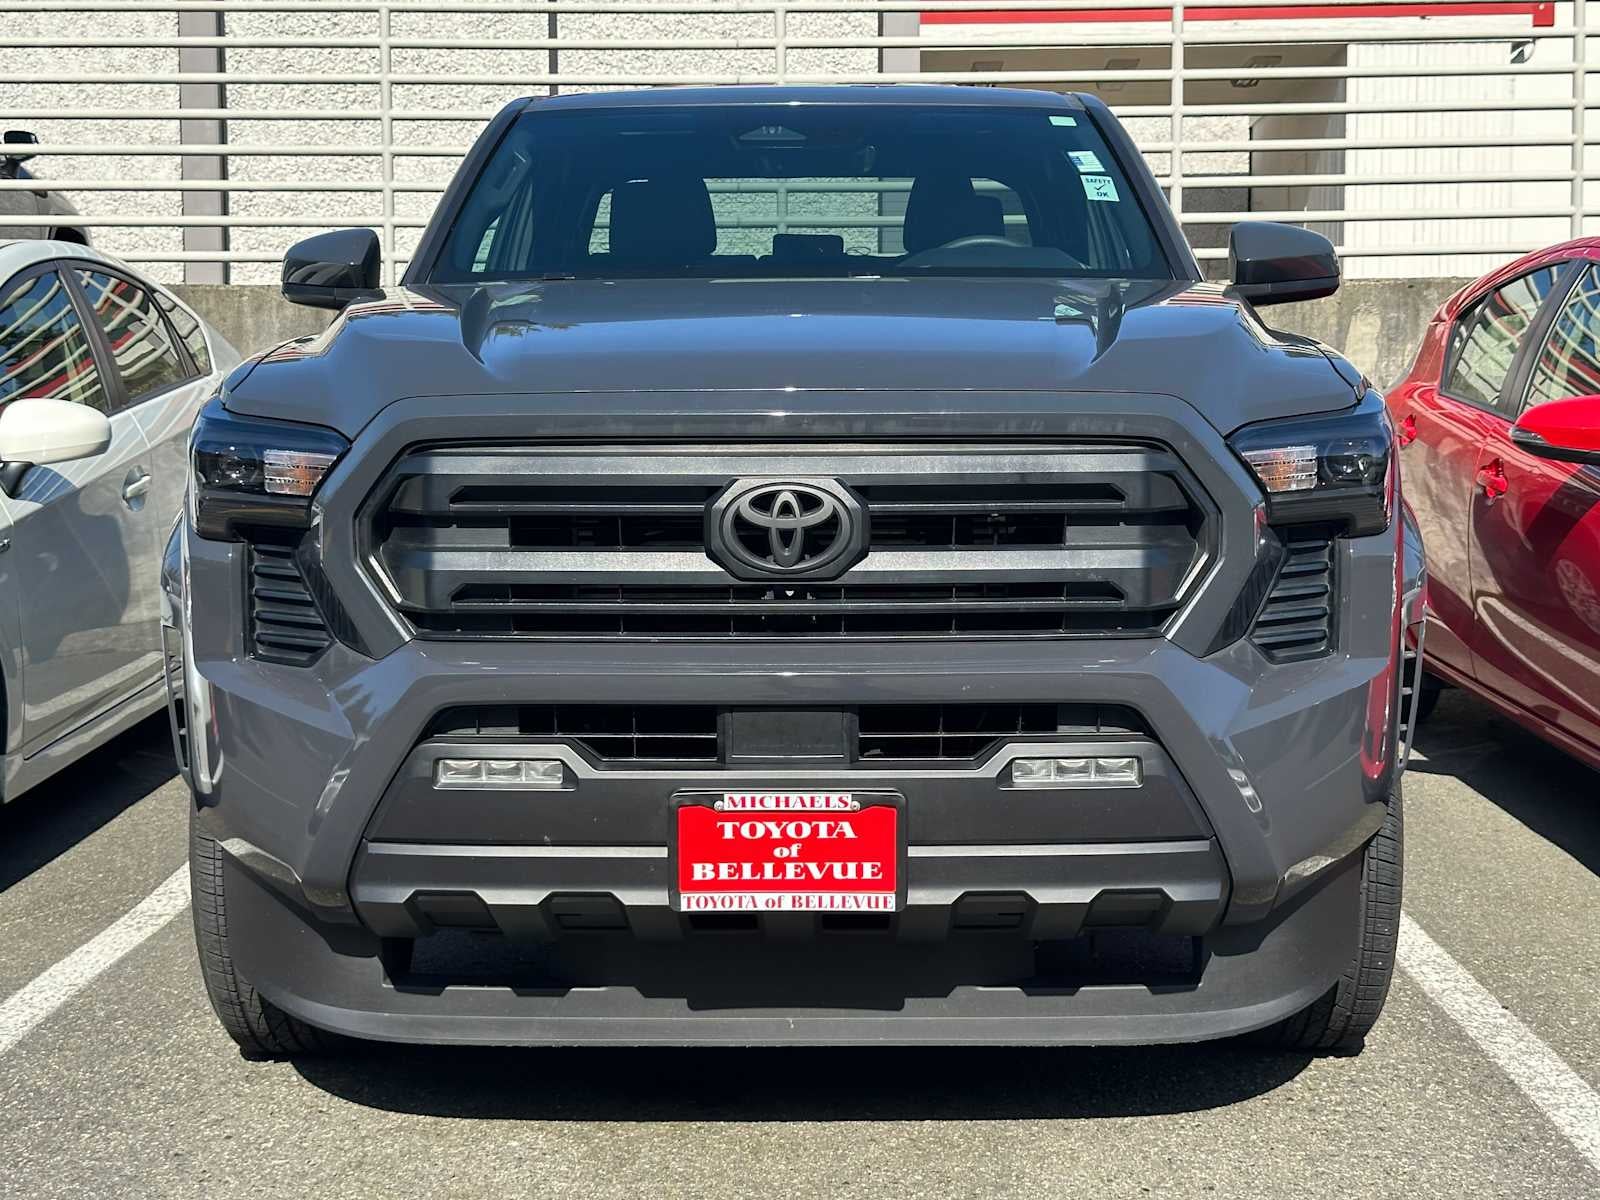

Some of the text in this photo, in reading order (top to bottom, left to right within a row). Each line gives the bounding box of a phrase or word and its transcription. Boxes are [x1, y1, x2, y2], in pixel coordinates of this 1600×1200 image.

[727, 795, 850, 808] MICHAELS
[717, 821, 857, 839] TOYOTA
[773, 843, 802, 858] of
[691, 862, 882, 880] BELLEVUE
[683, 895, 894, 909] TOYOTA of BELLEVUE
